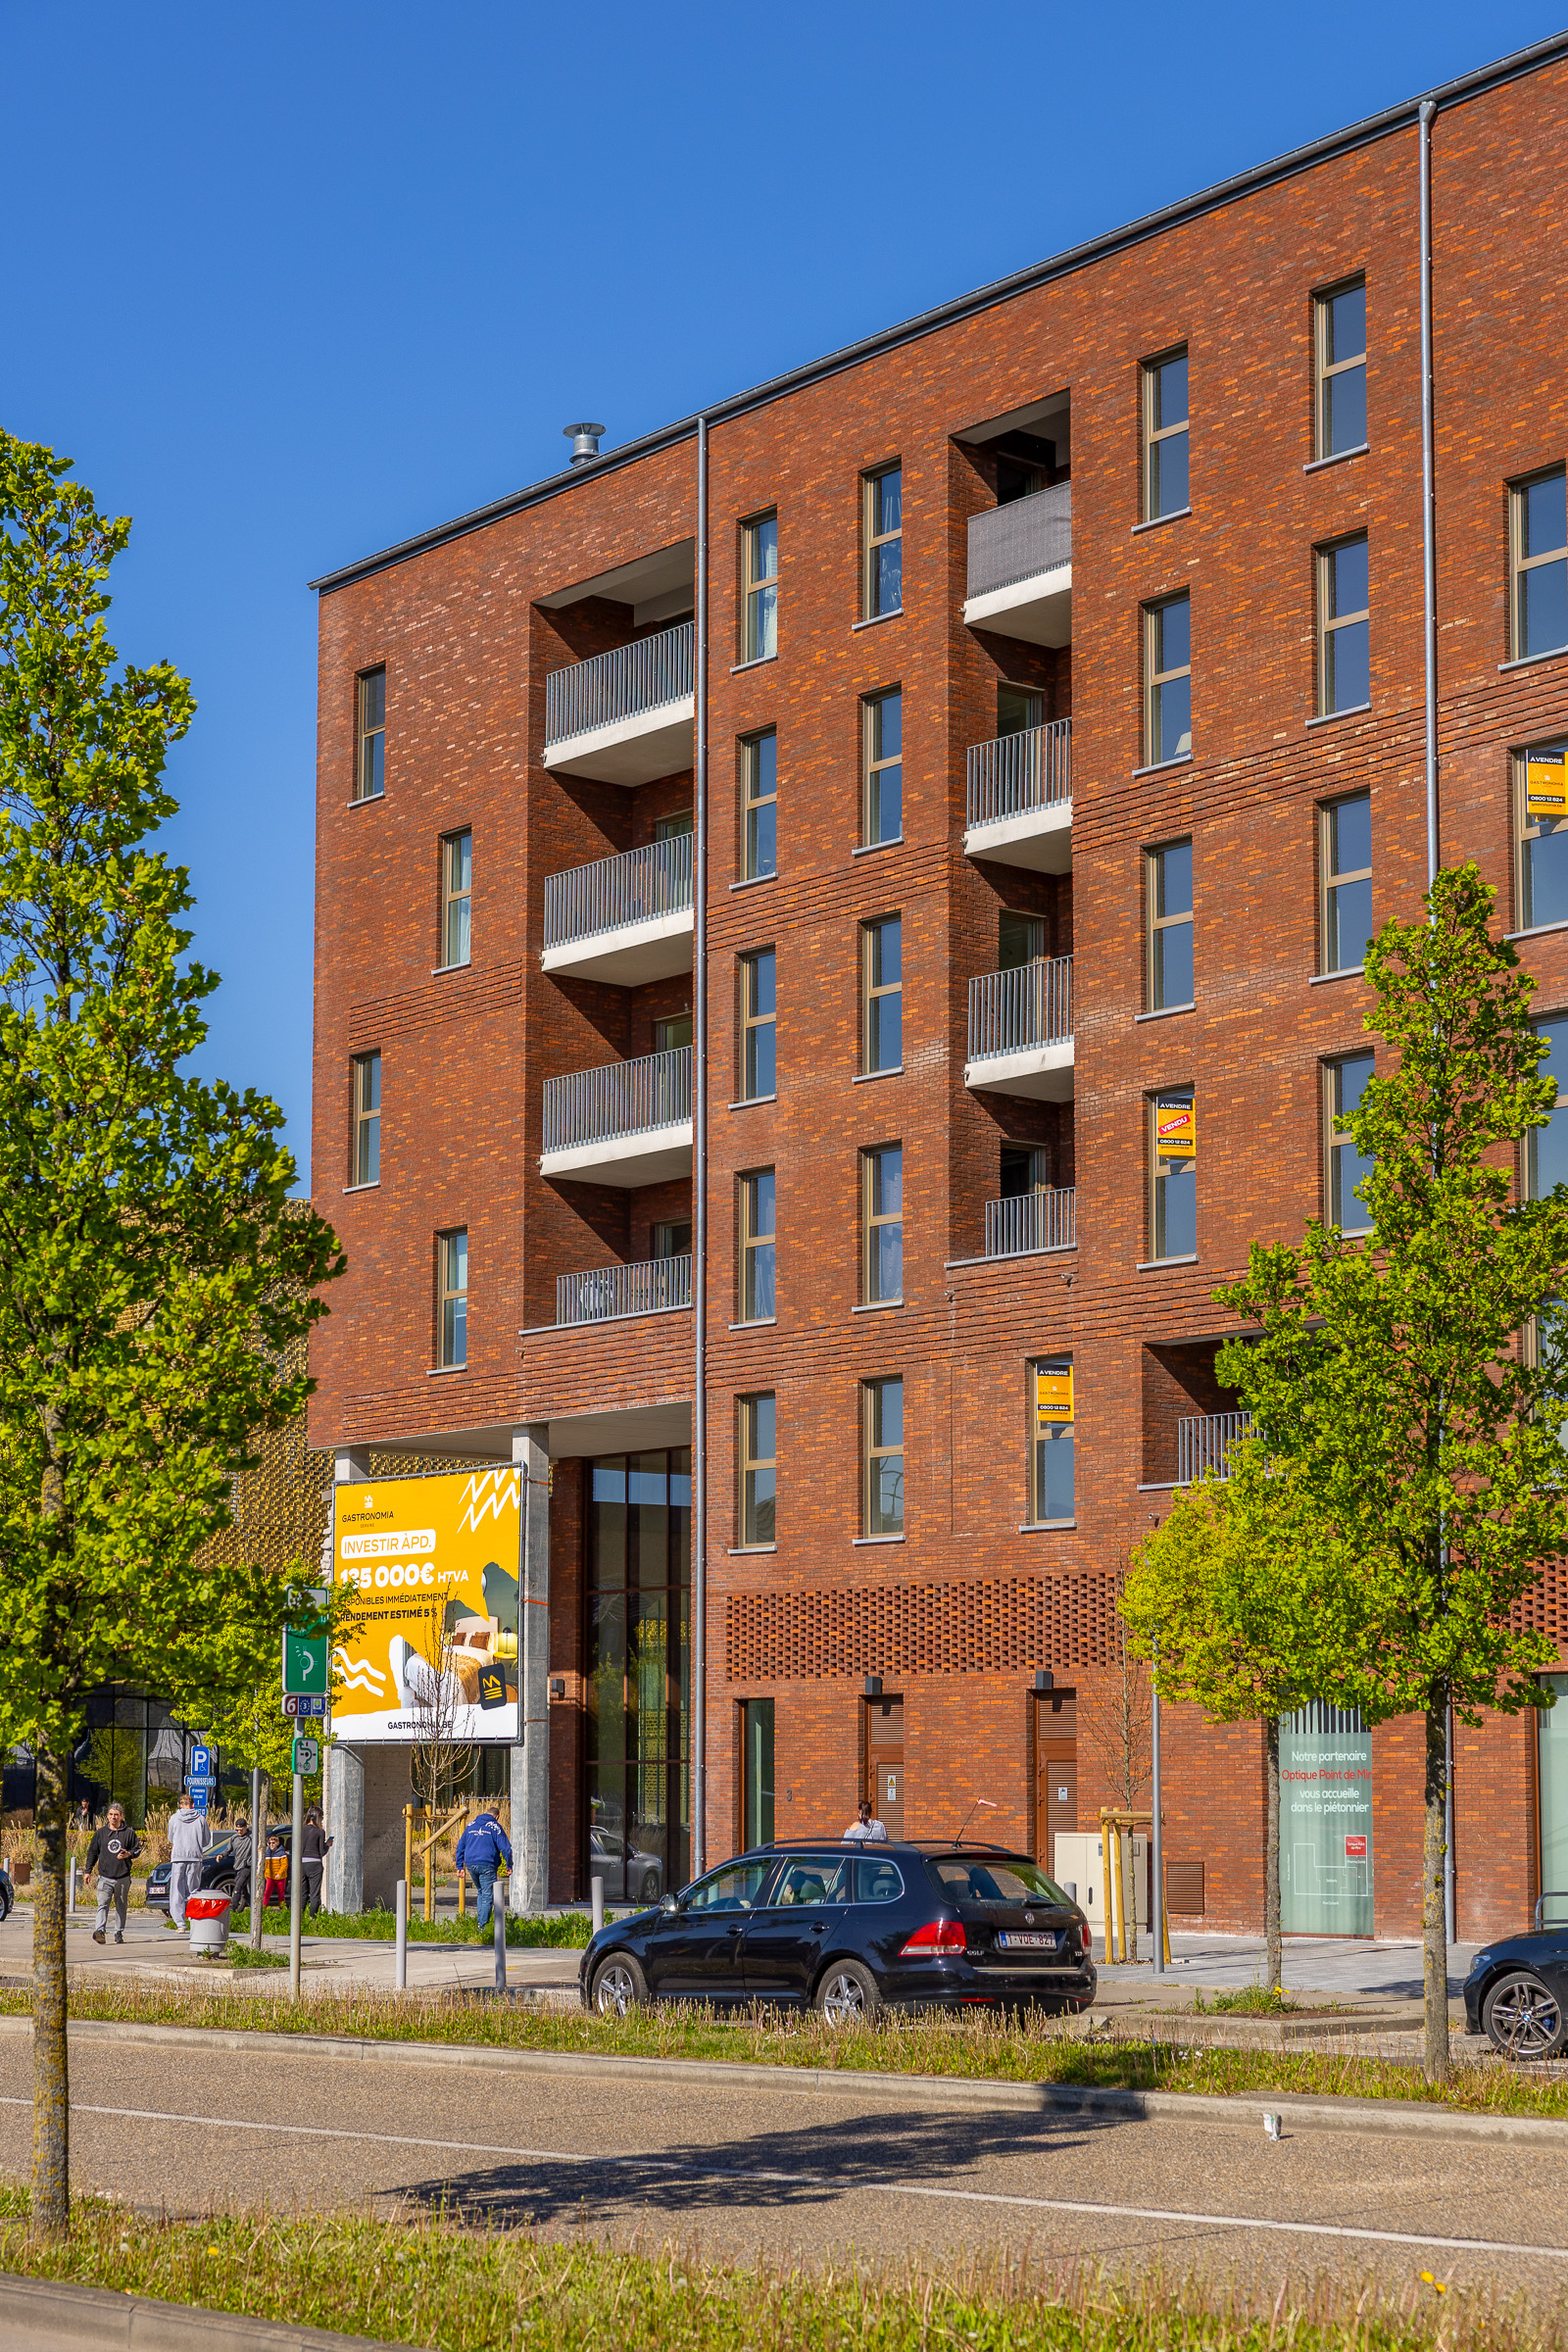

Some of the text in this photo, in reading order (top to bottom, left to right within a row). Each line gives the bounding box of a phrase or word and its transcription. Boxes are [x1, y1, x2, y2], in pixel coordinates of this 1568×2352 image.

[1161, 1116, 1187, 1132] VENDU
[342, 1511, 394, 1522] GASTRONOMIA
[344, 1533, 431, 1554] INVESTIR ÀPD.
[340, 1562, 469, 1589] 135 000€ HTVA
[344, 1592, 448, 1606] SPONIBLES IMMÉDIATEMENT
[340, 1611, 389, 1622] RENDEMENT
[390, 1607, 422, 1619] ESTIMÉ
[424, 1608, 430, 1617] 5
[287, 1697, 296, 1713] 6
[194, 1751, 207, 1771] P
[1292, 1750, 1367, 1764] Notre partenaire
[187, 1777, 214, 1786] FOURNISSEURS
[1282, 1769, 1317, 1782] Optique
[1319, 1769, 1342, 1780] Point
[1343, 1769, 1355, 1780] de
[786, 1789, 792, 1801] 3
[1299, 1788, 1359, 1799] vous accueille
[1291, 1801, 1369, 1815] dans le piétonnier
